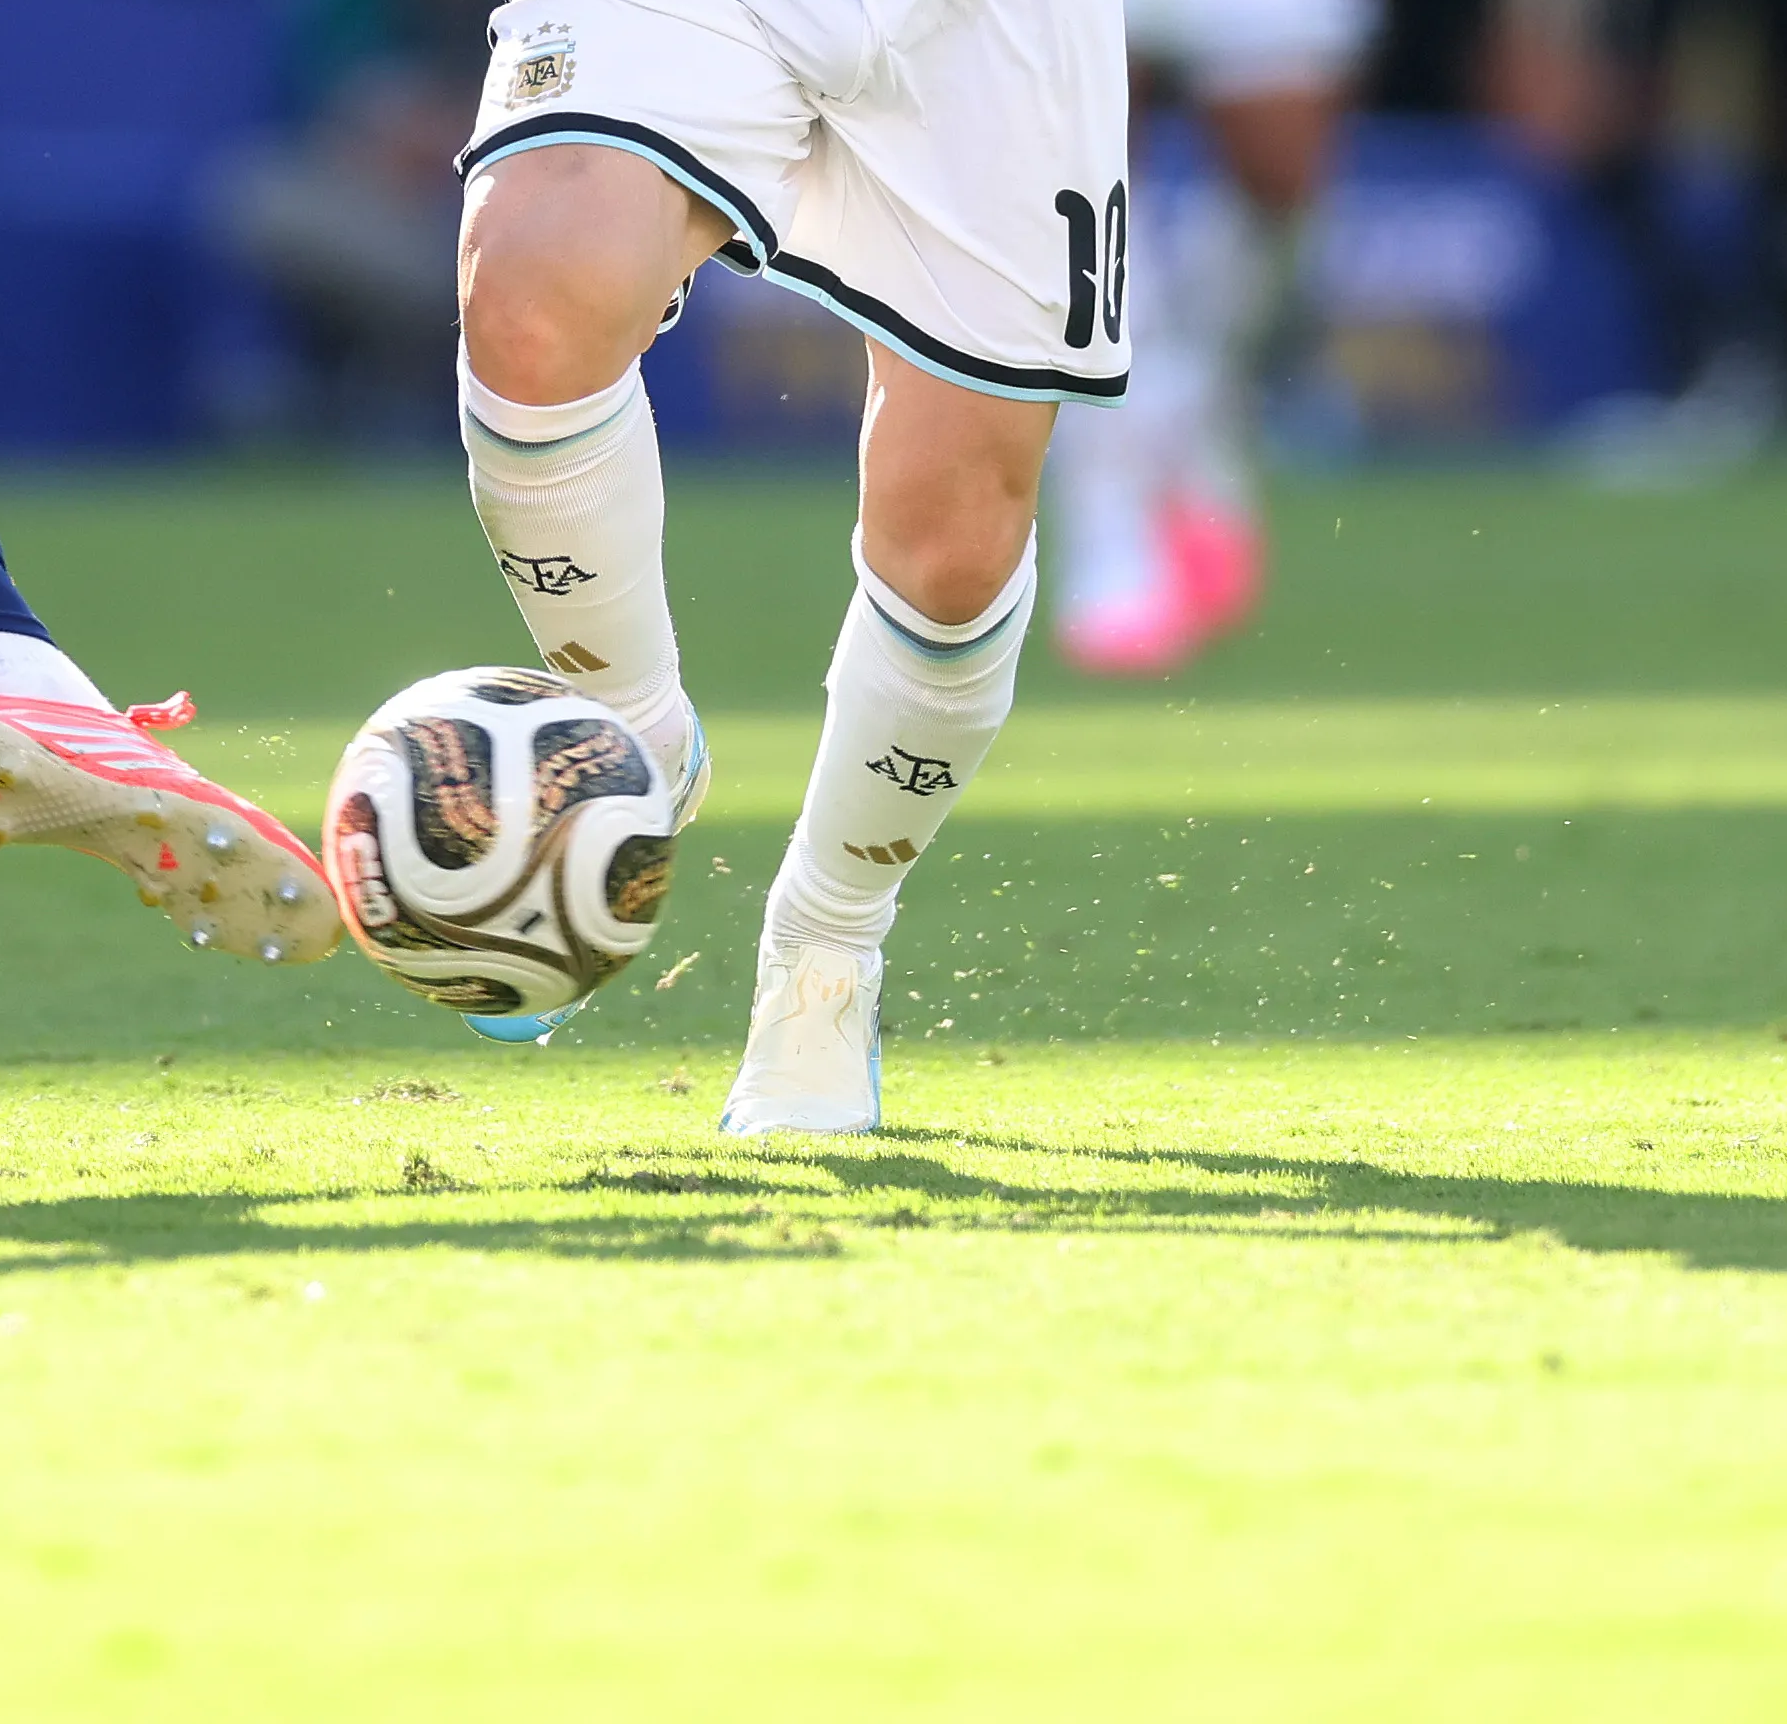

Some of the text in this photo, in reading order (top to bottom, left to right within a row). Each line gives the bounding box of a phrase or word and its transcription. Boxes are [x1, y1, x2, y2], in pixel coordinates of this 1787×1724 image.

[518, 55, 559, 89] AFA
[1054, 178, 1127, 349] 10
[500, 549, 598, 596] AFA
[864, 745, 959, 796] AFA
